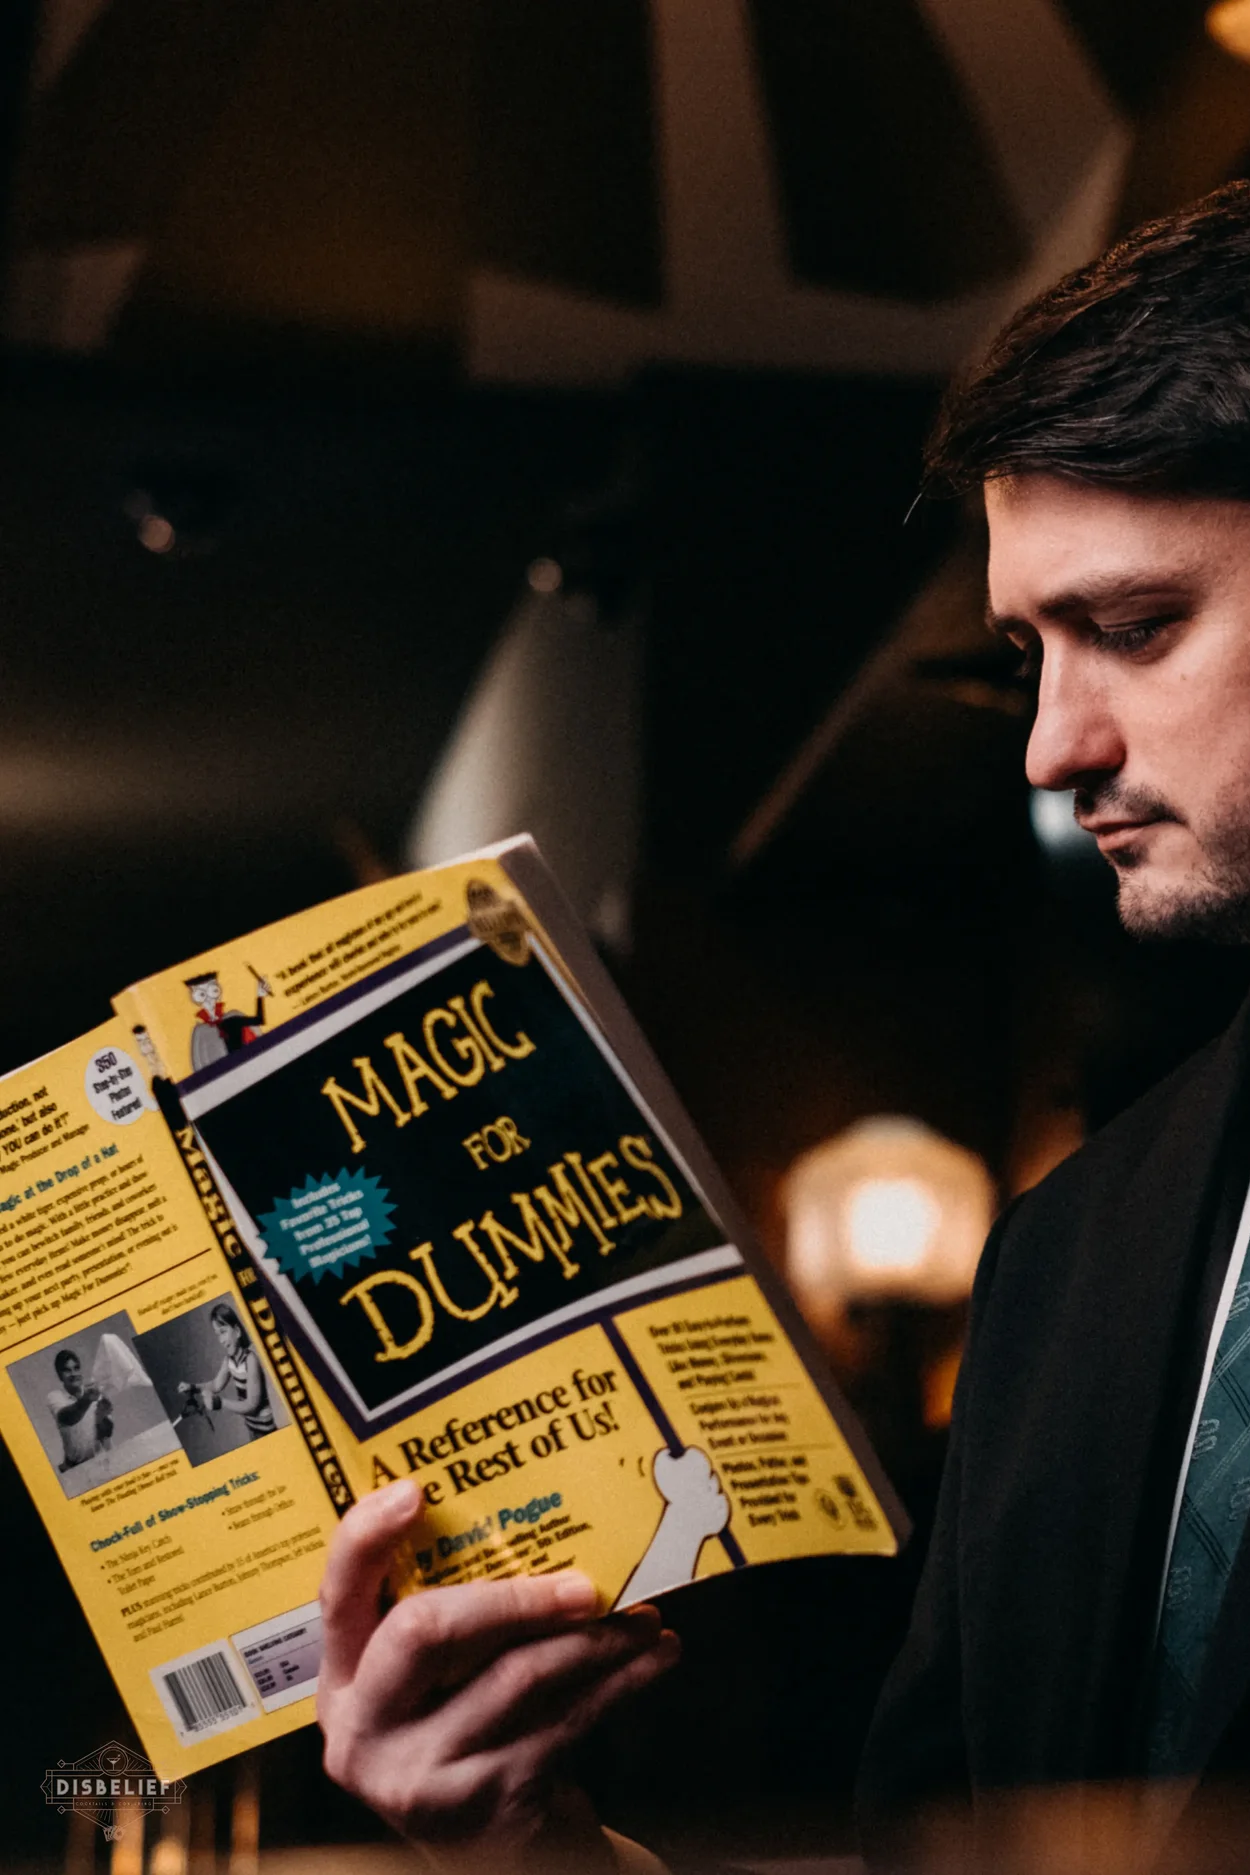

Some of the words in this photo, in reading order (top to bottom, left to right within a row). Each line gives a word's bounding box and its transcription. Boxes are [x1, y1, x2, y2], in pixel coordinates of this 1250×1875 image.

[321, 980, 537, 1154] MAGIC
[31, 1086, 48, 1101] not
[21, 1111, 37, 1125] but
[37, 1100, 57, 1117] also
[1, 1137, 23, 1155] YOU
[22, 1129, 40, 1144] can
[40, 1122, 53, 1135] do
[19, 1143, 50, 1164] Producer
[49, 1137, 62, 1148] and
[462, 1116, 530, 1170] FOR
[22, 1186, 35, 1198] at
[36, 1175, 54, 1191] the
[54, 1162, 80, 1183] Drop
[79, 1155, 92, 1169] of
[100, 1142, 118, 1158] Hat
[326, 1187, 364, 1209] Tricks
[48, 1210, 67, 1225] With
[16, 1247, 30, 1258] can
[340, 1135, 682, 1362] DUMMIES
[20, 1276, 36, 1289] and
[176, 1126, 241, 1258] Magic
[250, 1296, 350, 1507] Dummies
[371, 1455, 399, 1489] A
[399, 1385, 571, 1472] Reference
[572, 1369, 618, 1401] for
[444, 1441, 525, 1495] Rest
[530, 1420, 567, 1458] of
[567, 1402, 620, 1440] Us!
[89, 1521, 144, 1552] Chock-Full
[144, 1514, 156, 1527] of
[157, 1482, 229, 1523] Show-Stopping
[229, 1469, 259, 1489] Tricks:
[498, 1493, 561, 1530] Pogue
[121, 1602, 142, 1617] PLUS
